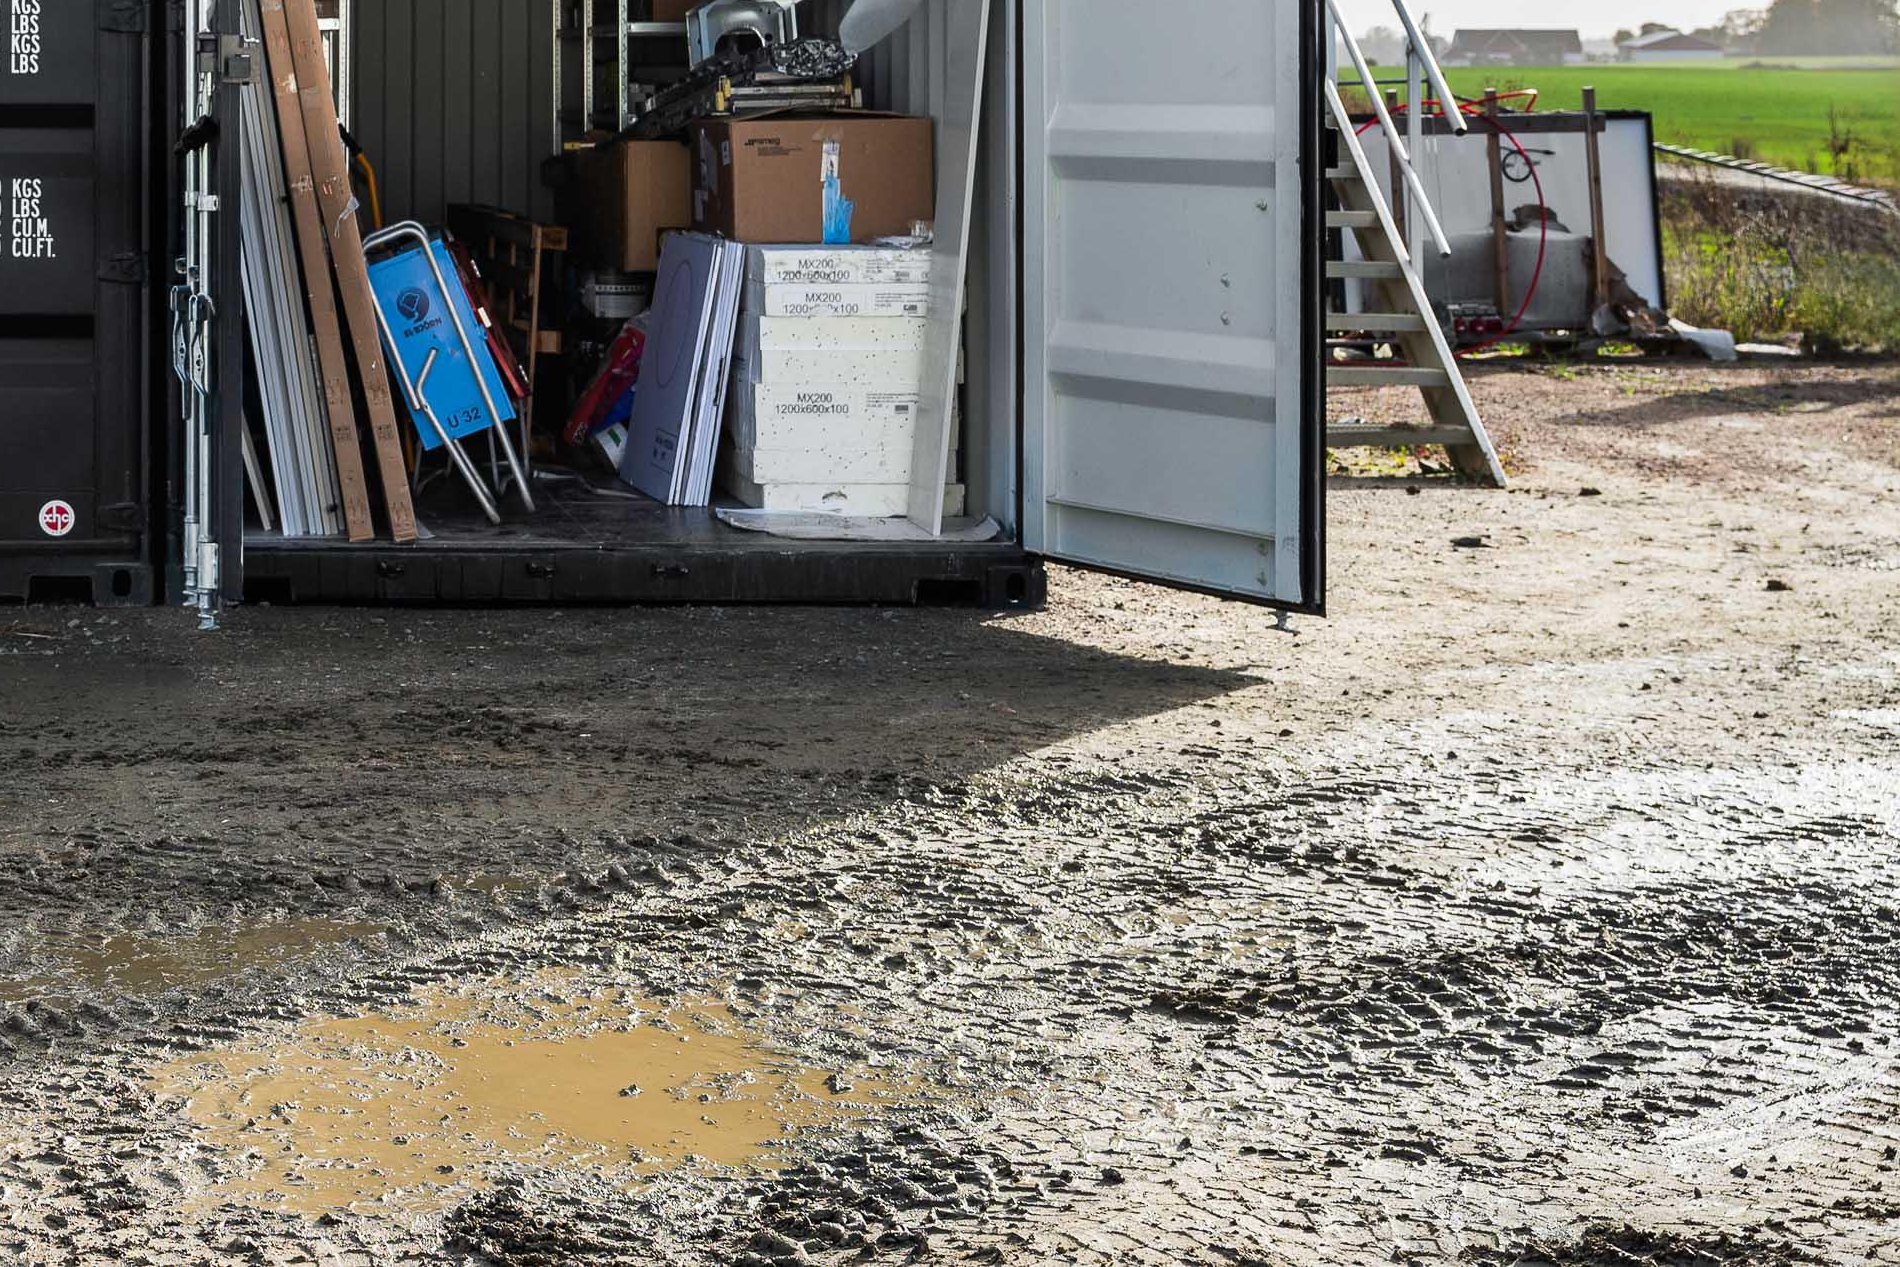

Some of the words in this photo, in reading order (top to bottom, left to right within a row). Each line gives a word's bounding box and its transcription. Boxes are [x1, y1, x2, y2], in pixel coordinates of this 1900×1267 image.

[11, 15, 39, 34] LBS
[11, 34, 41, 54] KGS
[11, 54, 39, 74] LBS
[12, 178, 42, 198] KGS
[12, 197, 40, 218] LBS
[12, 218, 52, 237] CU.M.
[12, 237, 56, 257] CU.FT.
[798, 258, 834, 269] MX200
[805, 293, 842, 303] MX200
[797, 393, 833, 403] MX200
[461, 406, 482, 423] 32
[775, 404, 849, 414] 1200x600x100
